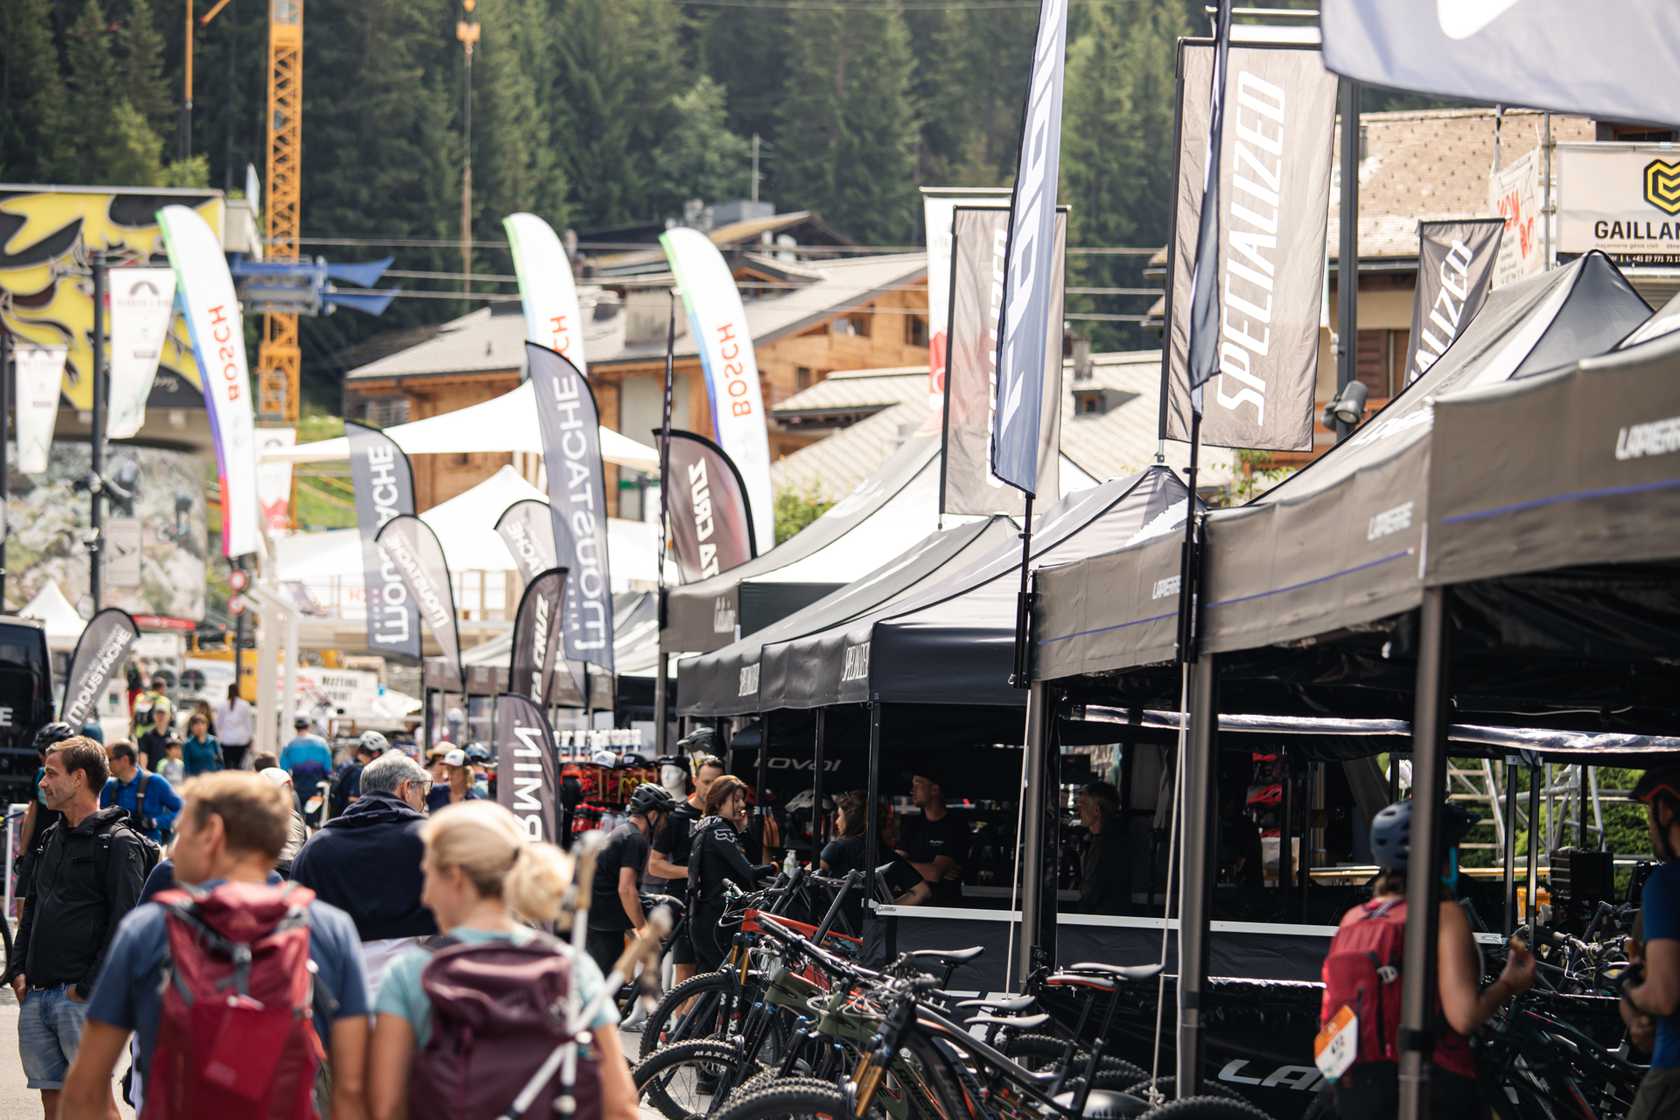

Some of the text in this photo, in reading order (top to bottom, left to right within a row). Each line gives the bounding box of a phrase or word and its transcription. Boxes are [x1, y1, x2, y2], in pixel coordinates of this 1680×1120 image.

[1217, 71, 1287, 427] SPECIALIZED
[68, 628, 132, 726] MOUSTACHE
[533, 592, 549, 671] CRUZ
